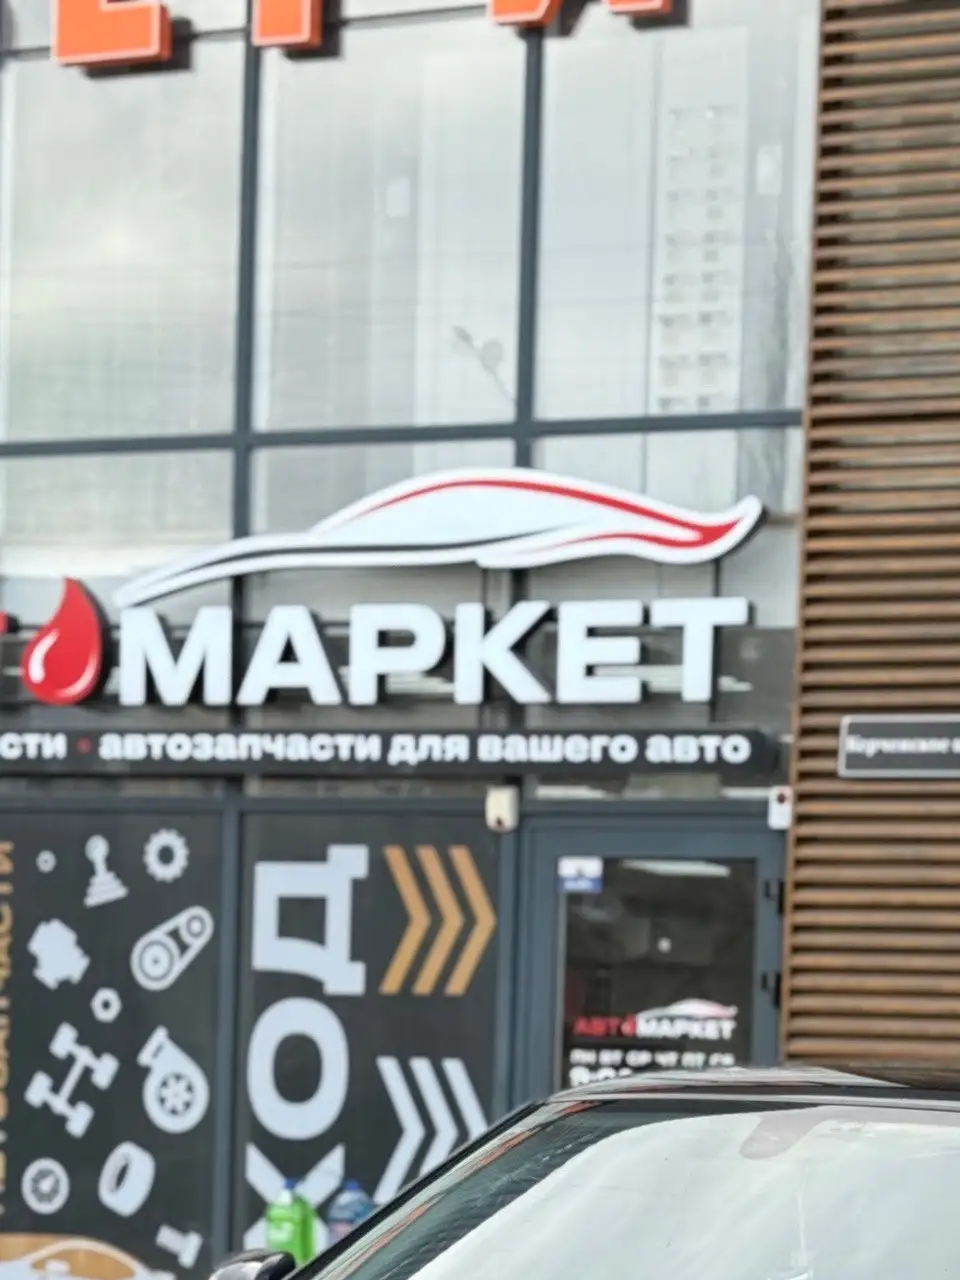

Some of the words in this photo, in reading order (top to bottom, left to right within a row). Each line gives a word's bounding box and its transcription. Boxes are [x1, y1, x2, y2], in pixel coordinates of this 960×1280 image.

[99, 733, 382, 761] автозапчасти
[387, 733, 470, 766] для
[477, 733, 639, 762] вашего
[645, 733, 751, 763] авто
